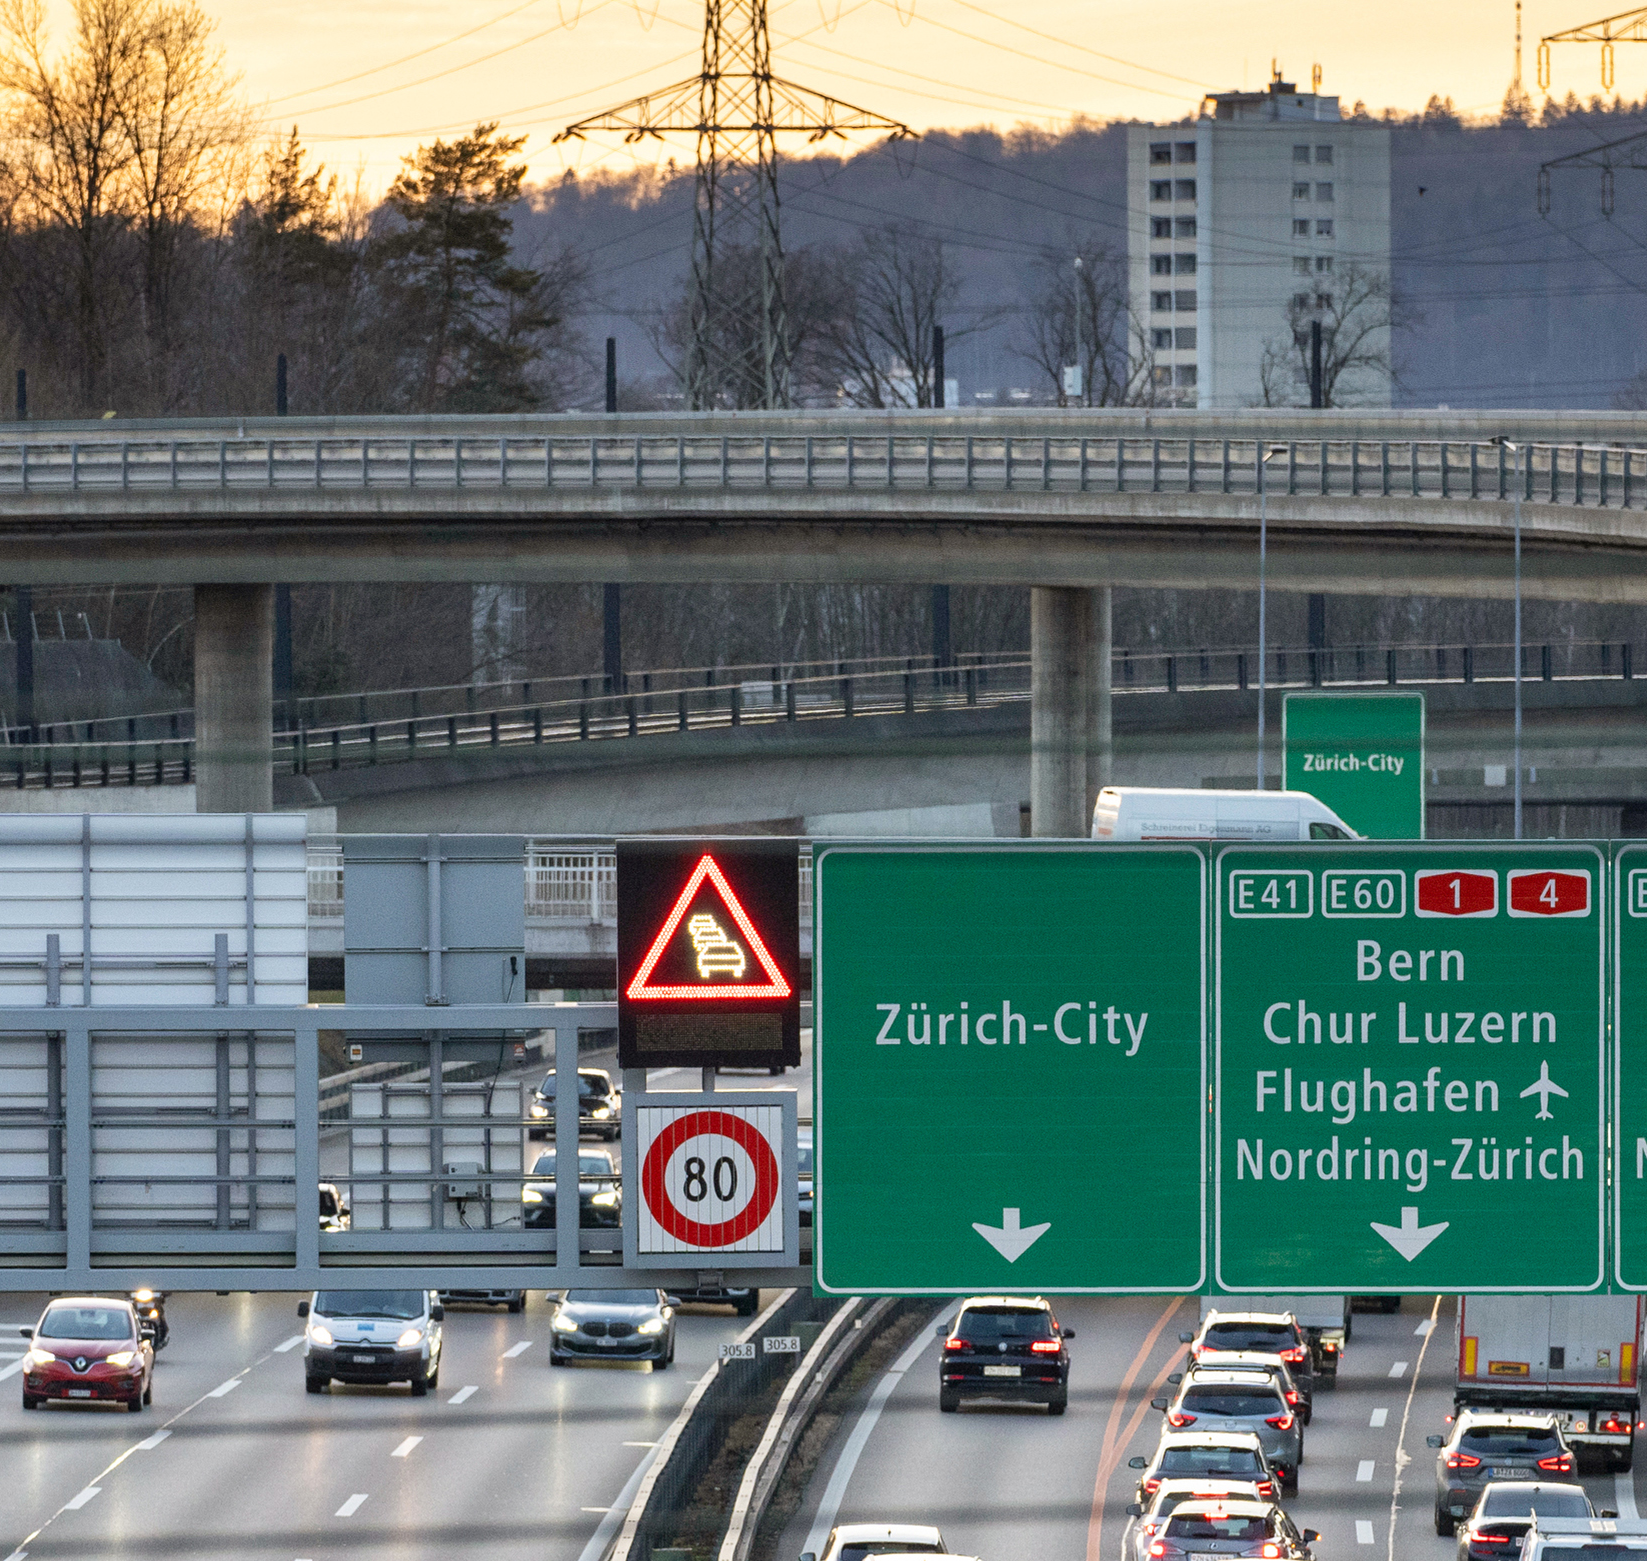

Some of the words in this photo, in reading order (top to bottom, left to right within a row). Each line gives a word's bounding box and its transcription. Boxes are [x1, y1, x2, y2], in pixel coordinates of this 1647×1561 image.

[1303, 752, 1405, 776] Zürich-City
[1238, 879, 1299, 910] E41
[1331, 879, 1395, 909] E60
[1448, 879, 1462, 909] 1
[1539, 879, 1559, 909] 4
[1356, 940, 1465, 982] Bern
[875, 1001, 1149, 1057] Zürich-City
[1262, 1000, 1377, 1045] Chur
[1398, 1001, 1557, 1044] Luzern
[1256, 1066, 1500, 1125] Flughafen
[683, 1156, 739, 1203] 80
[1236, 1135, 1584, 1193] Nordring-Zürich
[765, 1337, 799, 1352] 305.8
